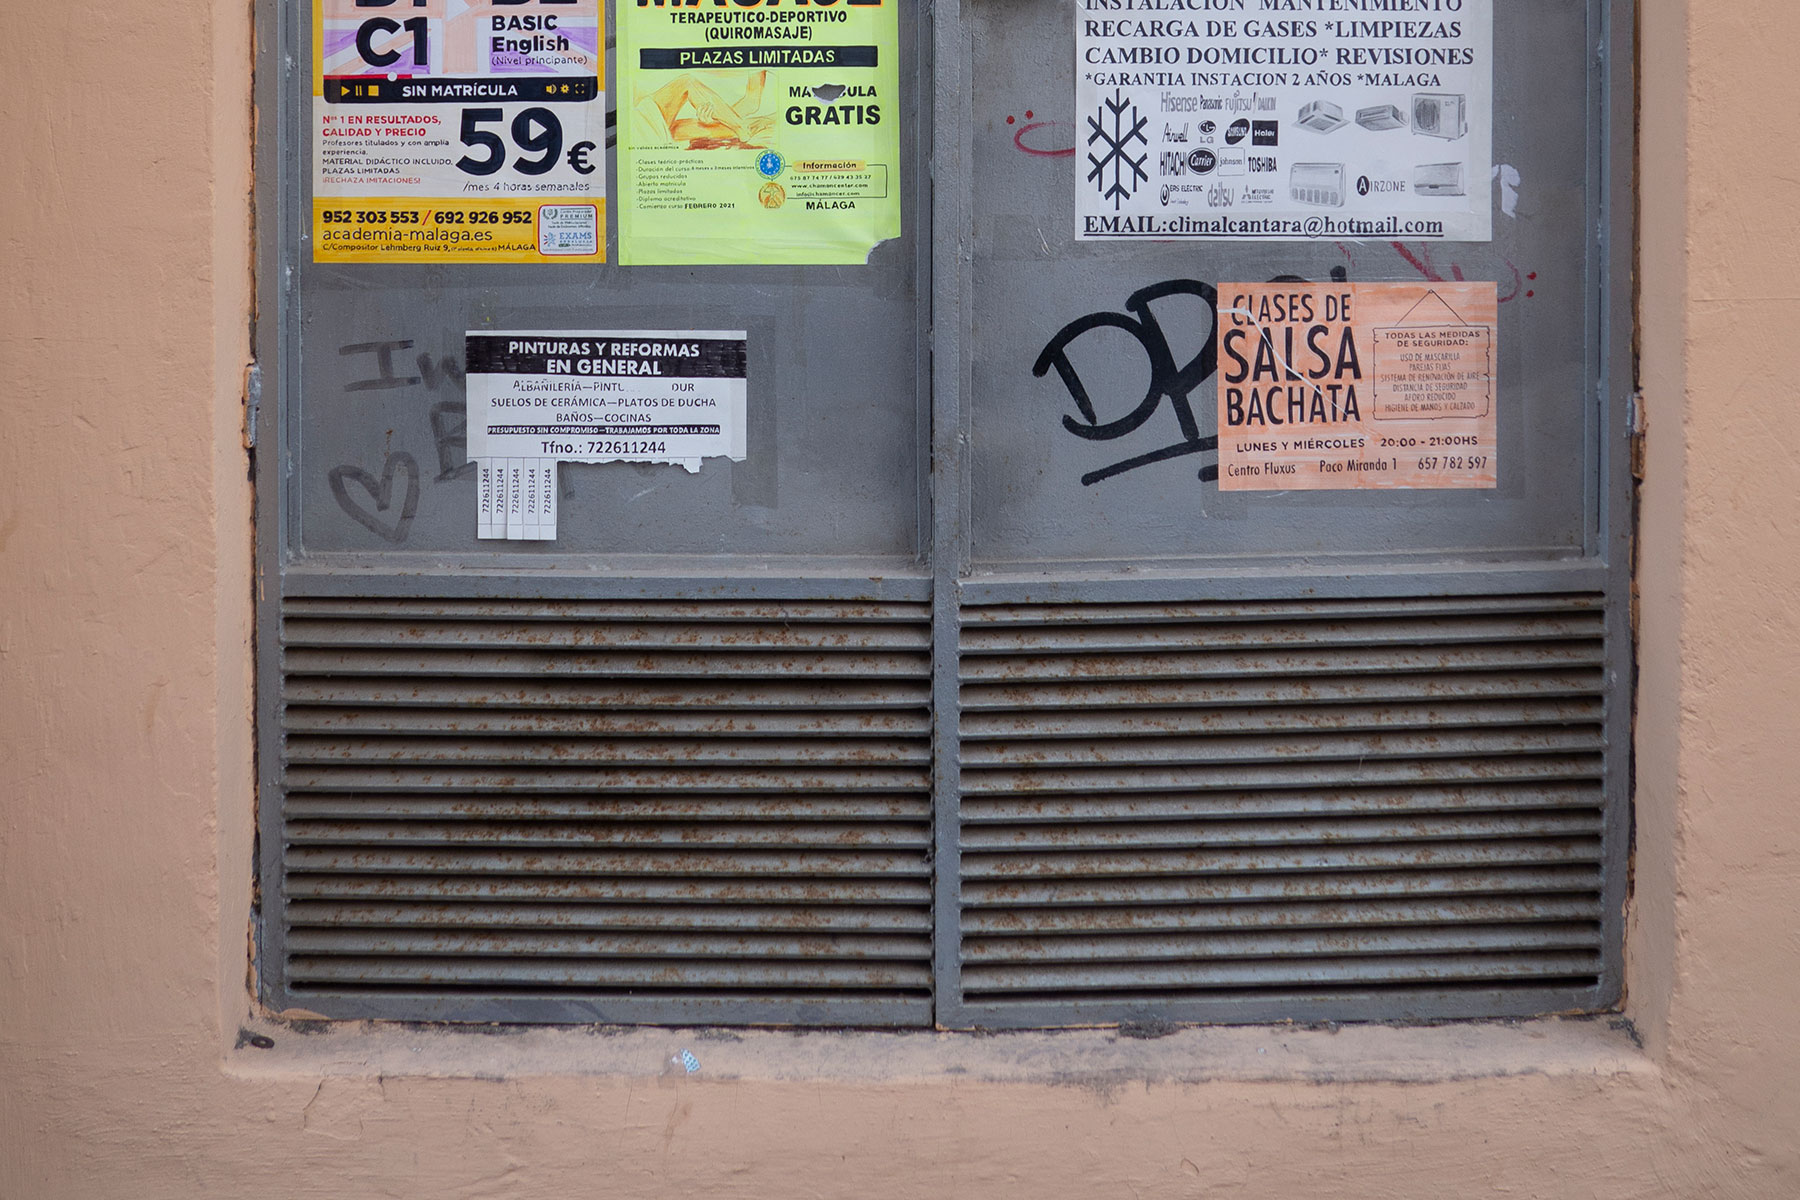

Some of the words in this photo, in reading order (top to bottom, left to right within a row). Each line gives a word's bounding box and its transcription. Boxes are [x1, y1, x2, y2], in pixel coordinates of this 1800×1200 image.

[491, 15, 558, 31] BASIC
[670, 11, 847, 24] TERAPEUTICO-DEPORTIVO
[705, 26, 812, 42] (QUIROMASAJE)
[1085, 20, 1200, 38] RECARGA
[1206, 20, 1237, 38] DE
[1243, 20, 1318, 38] GASES
[355, 16, 428, 67] C1
[492, 35, 569, 55] English
[491, 56, 522, 66] (Nivel
[680, 51, 744, 65] PLAZAS
[749, 50, 835, 64] LIMITADAS
[1085, 47, 1180, 65] CAMBIO
[1336, 48, 1474, 66] REVISIONES
[1191, 72, 1288, 87] INSTACION
[1305, 70, 1352, 87] AÑOS
[402, 85, 427, 98] SIN
[431, 82, 518, 97] MATRÍCULA
[348, 115, 363, 124] EN
[366, 115, 442, 125] RESULTADOS,
[785, 105, 881, 126] GRATIS
[322, 128, 372, 137] CALIDAD
[385, 128, 426, 137] PRECIO
[322, 139, 363, 147] Profesores
[365, 139, 399, 147] titulados
[322, 148, 369, 156] experiencia.
[366, 157, 411, 165] DIDÁCTICO
[803, 161, 857, 169] Información
[1248, 156, 1277, 172] TOSHIBA
[322, 167, 355, 175] PLAZAS
[357, 167, 400, 175] LIMITADAS
[503, 181, 533, 192] horas
[535, 181, 590, 192] semanales
[806, 199, 856, 210] MÁLAGA
[323, 210, 352, 224] 952
[357, 210, 388, 224] 303
[391, 210, 419, 224] 553
[435, 211, 466, 224] 692
[468, 211, 499, 224] 926
[502, 211, 532, 224] 952
[322, 228, 492, 244] academia-malaga.es
[559, 232, 593, 240] EXAMS
[322, 243, 379, 252] C/Compositor
[380, 243, 422, 252] Lehmberg
[424, 243, 442, 251] Ruiz
[498, 242, 536, 251] MÁLAGA
[1232, 294, 1314, 326] CLASES
[1325, 294, 1351, 322] DE
[1419, 331, 1436, 339] LAS
[1439, 330, 1481, 338] MEDIDAS
[508, 341, 591, 356] PINTURAS
[611, 343, 700, 358] REFORMAS
[1412, 339, 1469, 347] SEGURIDAD:
[1223, 324, 1362, 384] SALSA
[546, 359, 572, 374] EN
[577, 359, 662, 375] GENERAL
[491, 398, 532, 408] SUELOS
[534, 398, 548, 408] DE
[661, 398, 675, 408] DE
[678, 398, 716, 408] DUCHA
[1226, 384, 1361, 426] BACHATA
[488, 426, 535, 434] PRESUPUESTO
[537, 426, 549, 434] SIN
[653, 426, 668, 435] POR
[669, 426, 689, 435] TODA
[700, 426, 720, 435] ZONA
[587, 441, 666, 454] 722611244
[1236, 441, 1277, 453] LUNES
[1282, 441, 1290, 451] Y
[1293, 438, 1365, 450] MIÉRCOLES
[1380, 437, 1415, 448] 20:00
[1228, 463, 1260, 477] Centro
[1264, 462, 1296, 475] Fluxus
[1319, 460, 1343, 473] Paco
[1347, 458, 1388, 472] Miranda
[1418, 457, 1438, 470] 657
[1442, 456, 1463, 470] 782
[1467, 456, 1487, 470] 597
[496, 468, 504, 514] 722611244
[512, 468, 520, 514] 722611244
[528, 468, 536, 514] 722611244
[544, 468, 552, 514] 722611244
